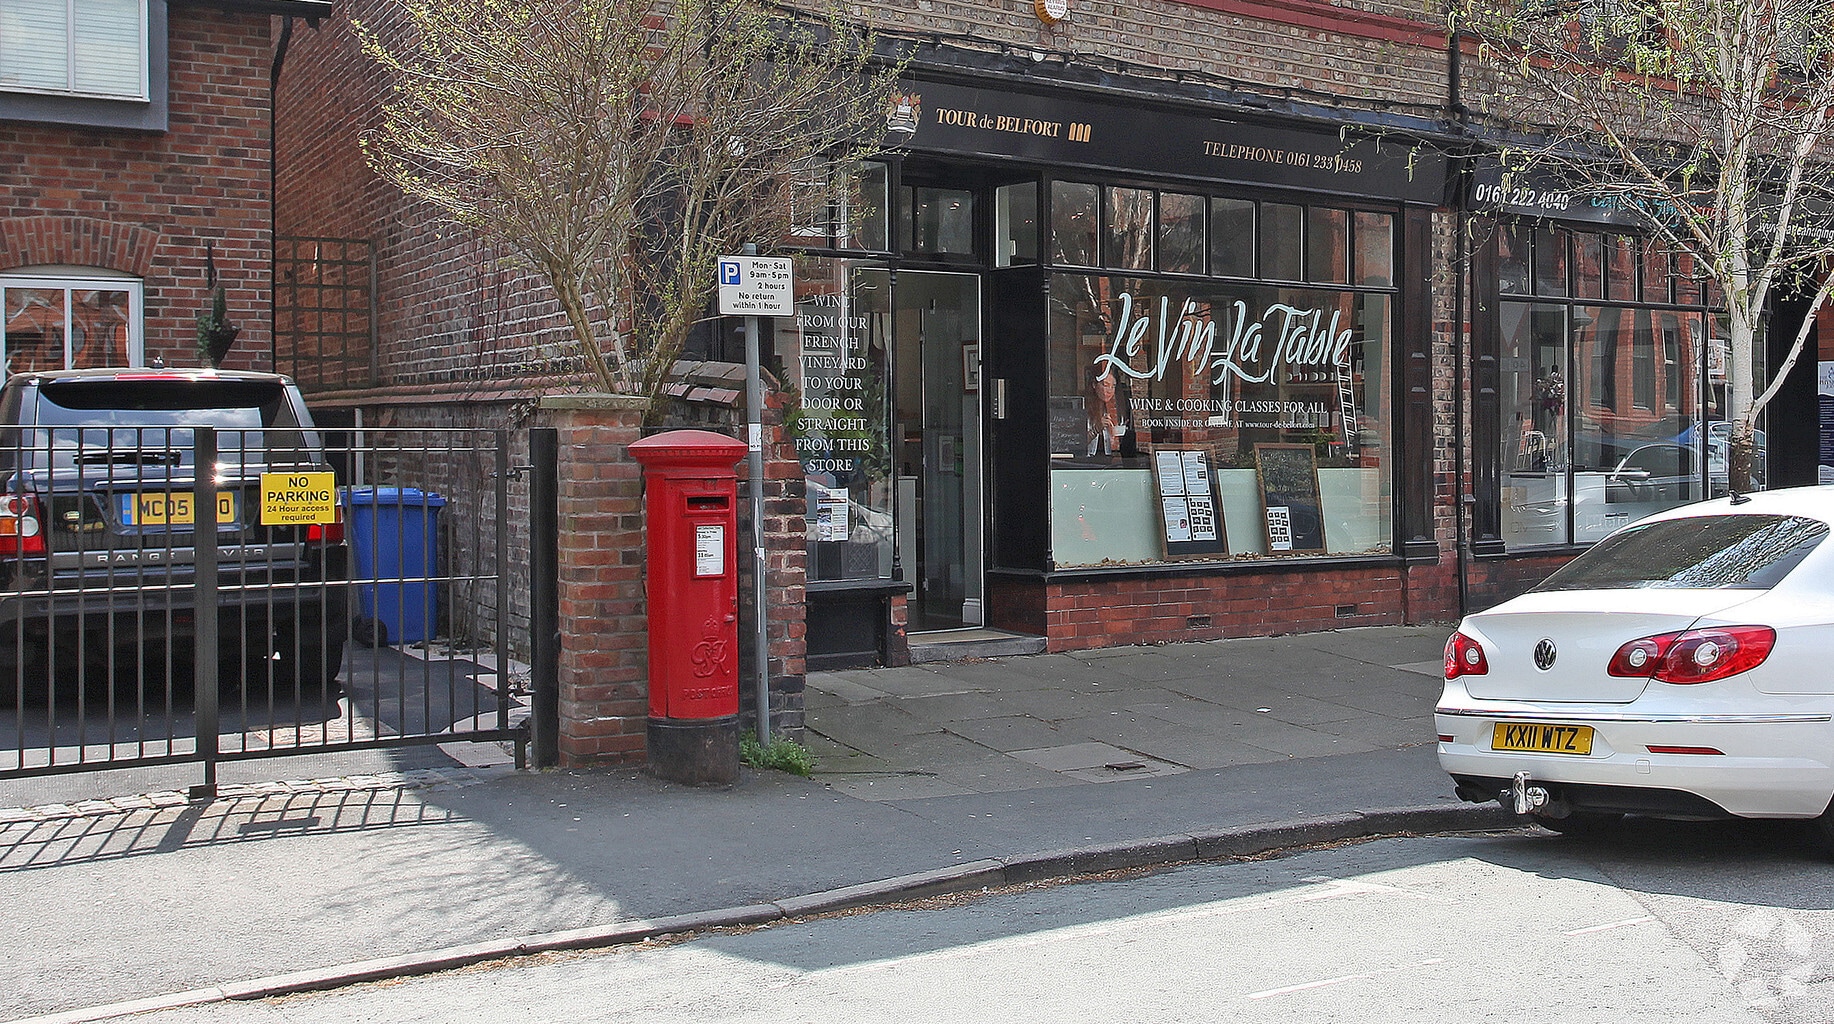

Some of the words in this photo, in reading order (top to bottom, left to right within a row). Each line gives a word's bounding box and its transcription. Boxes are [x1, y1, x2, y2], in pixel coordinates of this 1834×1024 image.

[936, 107, 977, 128] TOUR
[979, 114, 994, 129] de
[996, 115, 1062, 138] BELFORT
[1203, 141, 1284, 164] TELEPHONE
[1286, 151, 1310, 167] 0161
[1313, 155, 1333, 170] 233
[1475, 184, 1507, 204] 0161
[1511, 188, 1536, 206] 222
[1537, 191, 1568, 210] 4040
[738, 292, 750, 300] No
[796, 315, 834, 328] FROM
[838, 317, 868, 329] OUR
[804, 335, 859, 350] FRENCH
[1093, 292, 1157, 382] Le
[1157, 295, 1216, 382] Vin
[1211, 300, 1270, 386] La
[1262, 302, 1353, 386] Table
[798, 356, 867, 370] VINEYARD
[801, 376, 821, 389] TO
[825, 377, 863, 390] YOUR
[800, 397, 841, 410] DOOR
[844, 397, 863, 410] OR
[1129, 398, 1162, 411] WINE
[1164, 398, 1174, 411] &
[1176, 398, 1233, 412] COOKING
[1234, 400, 1281, 413] CLASSES
[1283, 401, 1306, 413] FOR
[1307, 402, 1328, 414] ALL
[797, 417, 868, 431] STRAIGHT
[1142, 418, 1164, 427] BOOK
[1165, 419, 1191, 428] INSIDE
[1192, 419, 1203, 428] OR
[1235, 420, 1244, 428] AT
[795, 438, 834, 451] FROM
[837, 438, 870, 451] THIS
[808, 458, 853, 472] STORE
[288, 477, 309, 488] NO
[267, 490, 330, 502] PARKING
[281, 514, 316, 522] required
[1504, 725, 1538, 748] KX11
[1541, 726, 1579, 750] WTZ
